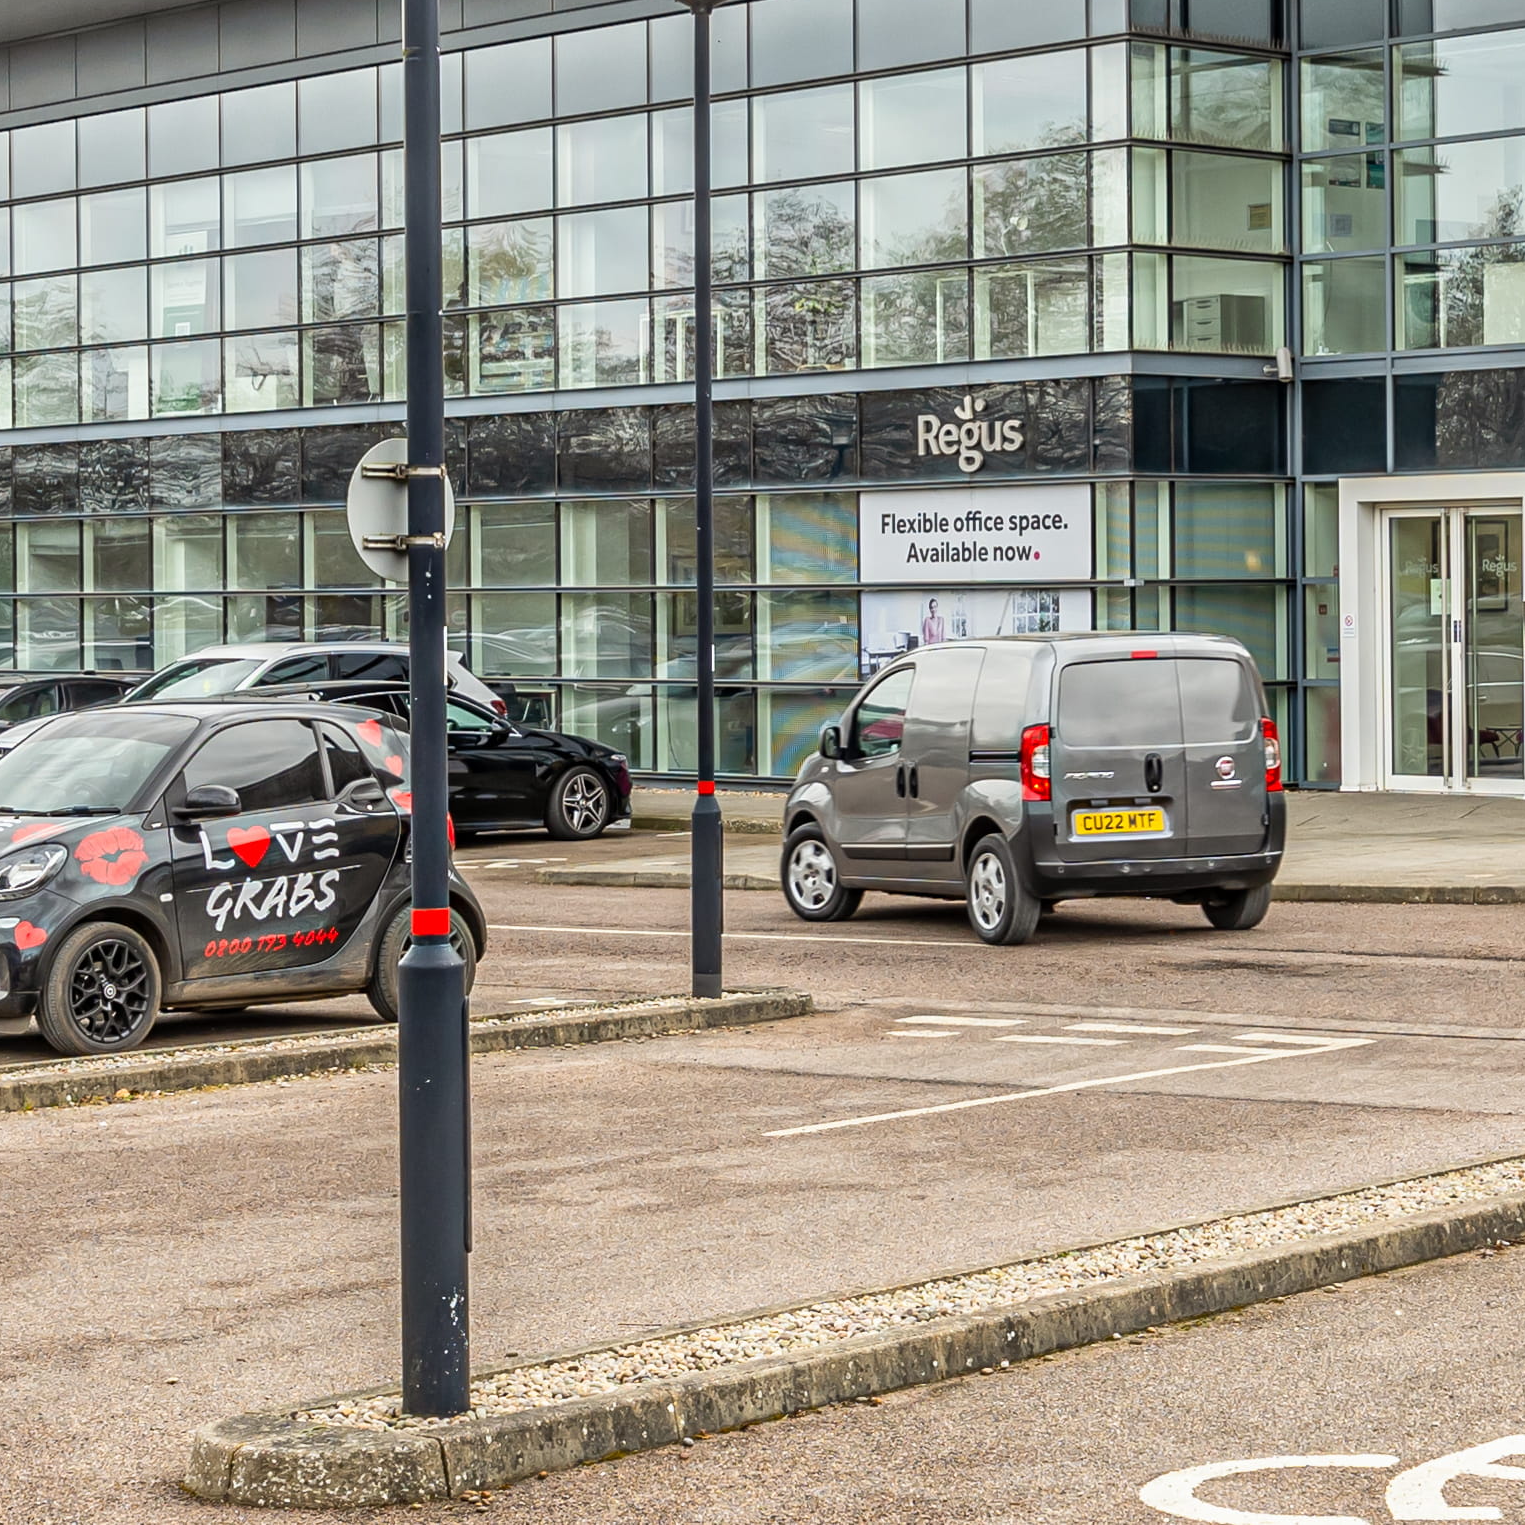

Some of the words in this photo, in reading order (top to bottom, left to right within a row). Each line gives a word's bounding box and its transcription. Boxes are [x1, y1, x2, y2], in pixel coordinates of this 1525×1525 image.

[917, 414, 1024, 473] Regus
[881, 512, 949, 535] Flexible
[953, 510, 1004, 532] office
[1008, 513, 1069, 536] space.
[906, 541, 989, 564] Available
[1482, 558, 1518, 578] Regus
[1083, 814, 1124, 831] CU22
[206, 869, 340, 932] GRABS
[204, 936, 252, 958] 0800
[292, 926, 339, 947] 4044
